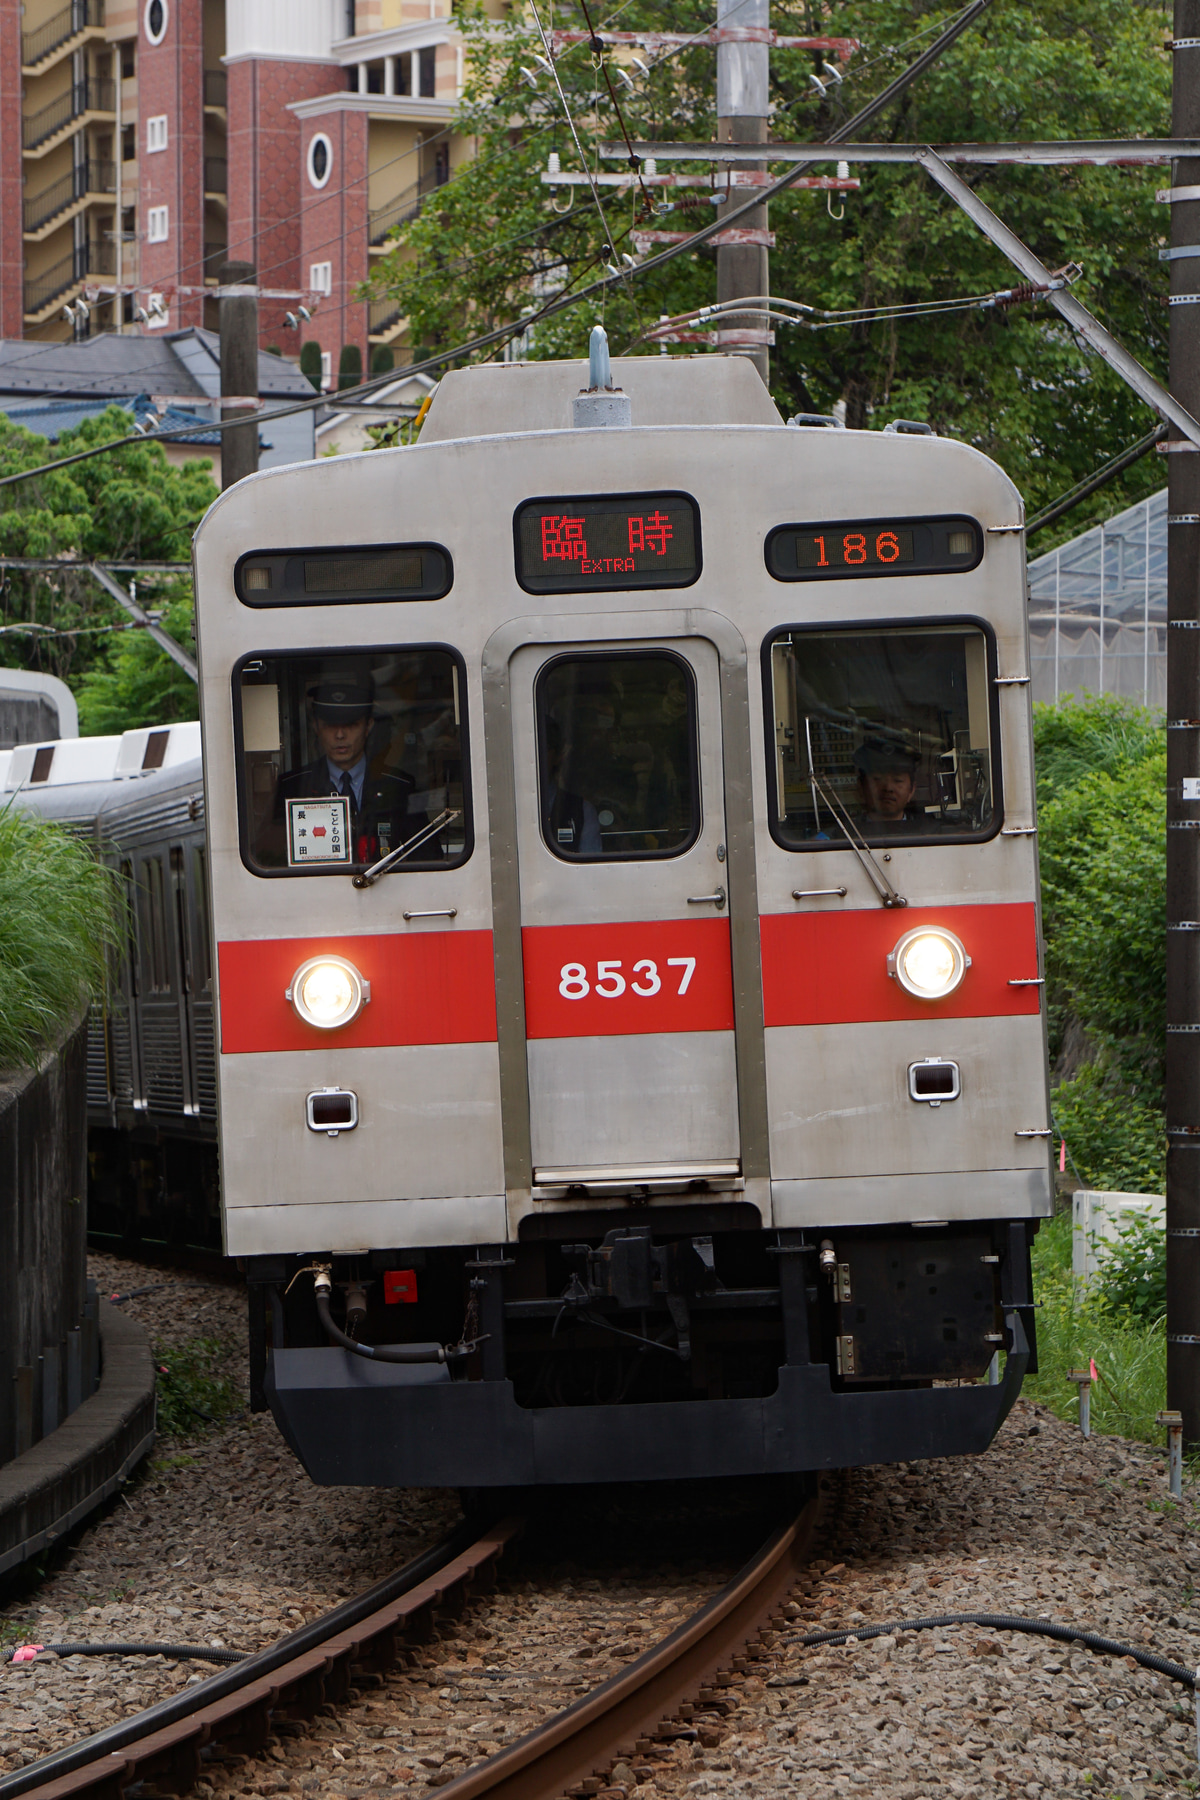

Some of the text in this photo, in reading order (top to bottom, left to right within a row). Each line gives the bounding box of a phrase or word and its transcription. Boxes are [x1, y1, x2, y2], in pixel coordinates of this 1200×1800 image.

[581, 557, 635, 574] EXTRA
[814, 531, 900, 567] 186
[297, 811, 307, 855] 長津田
[331, 809, 340, 853] こどもの国
[558, 957, 696, 1000] 8537
